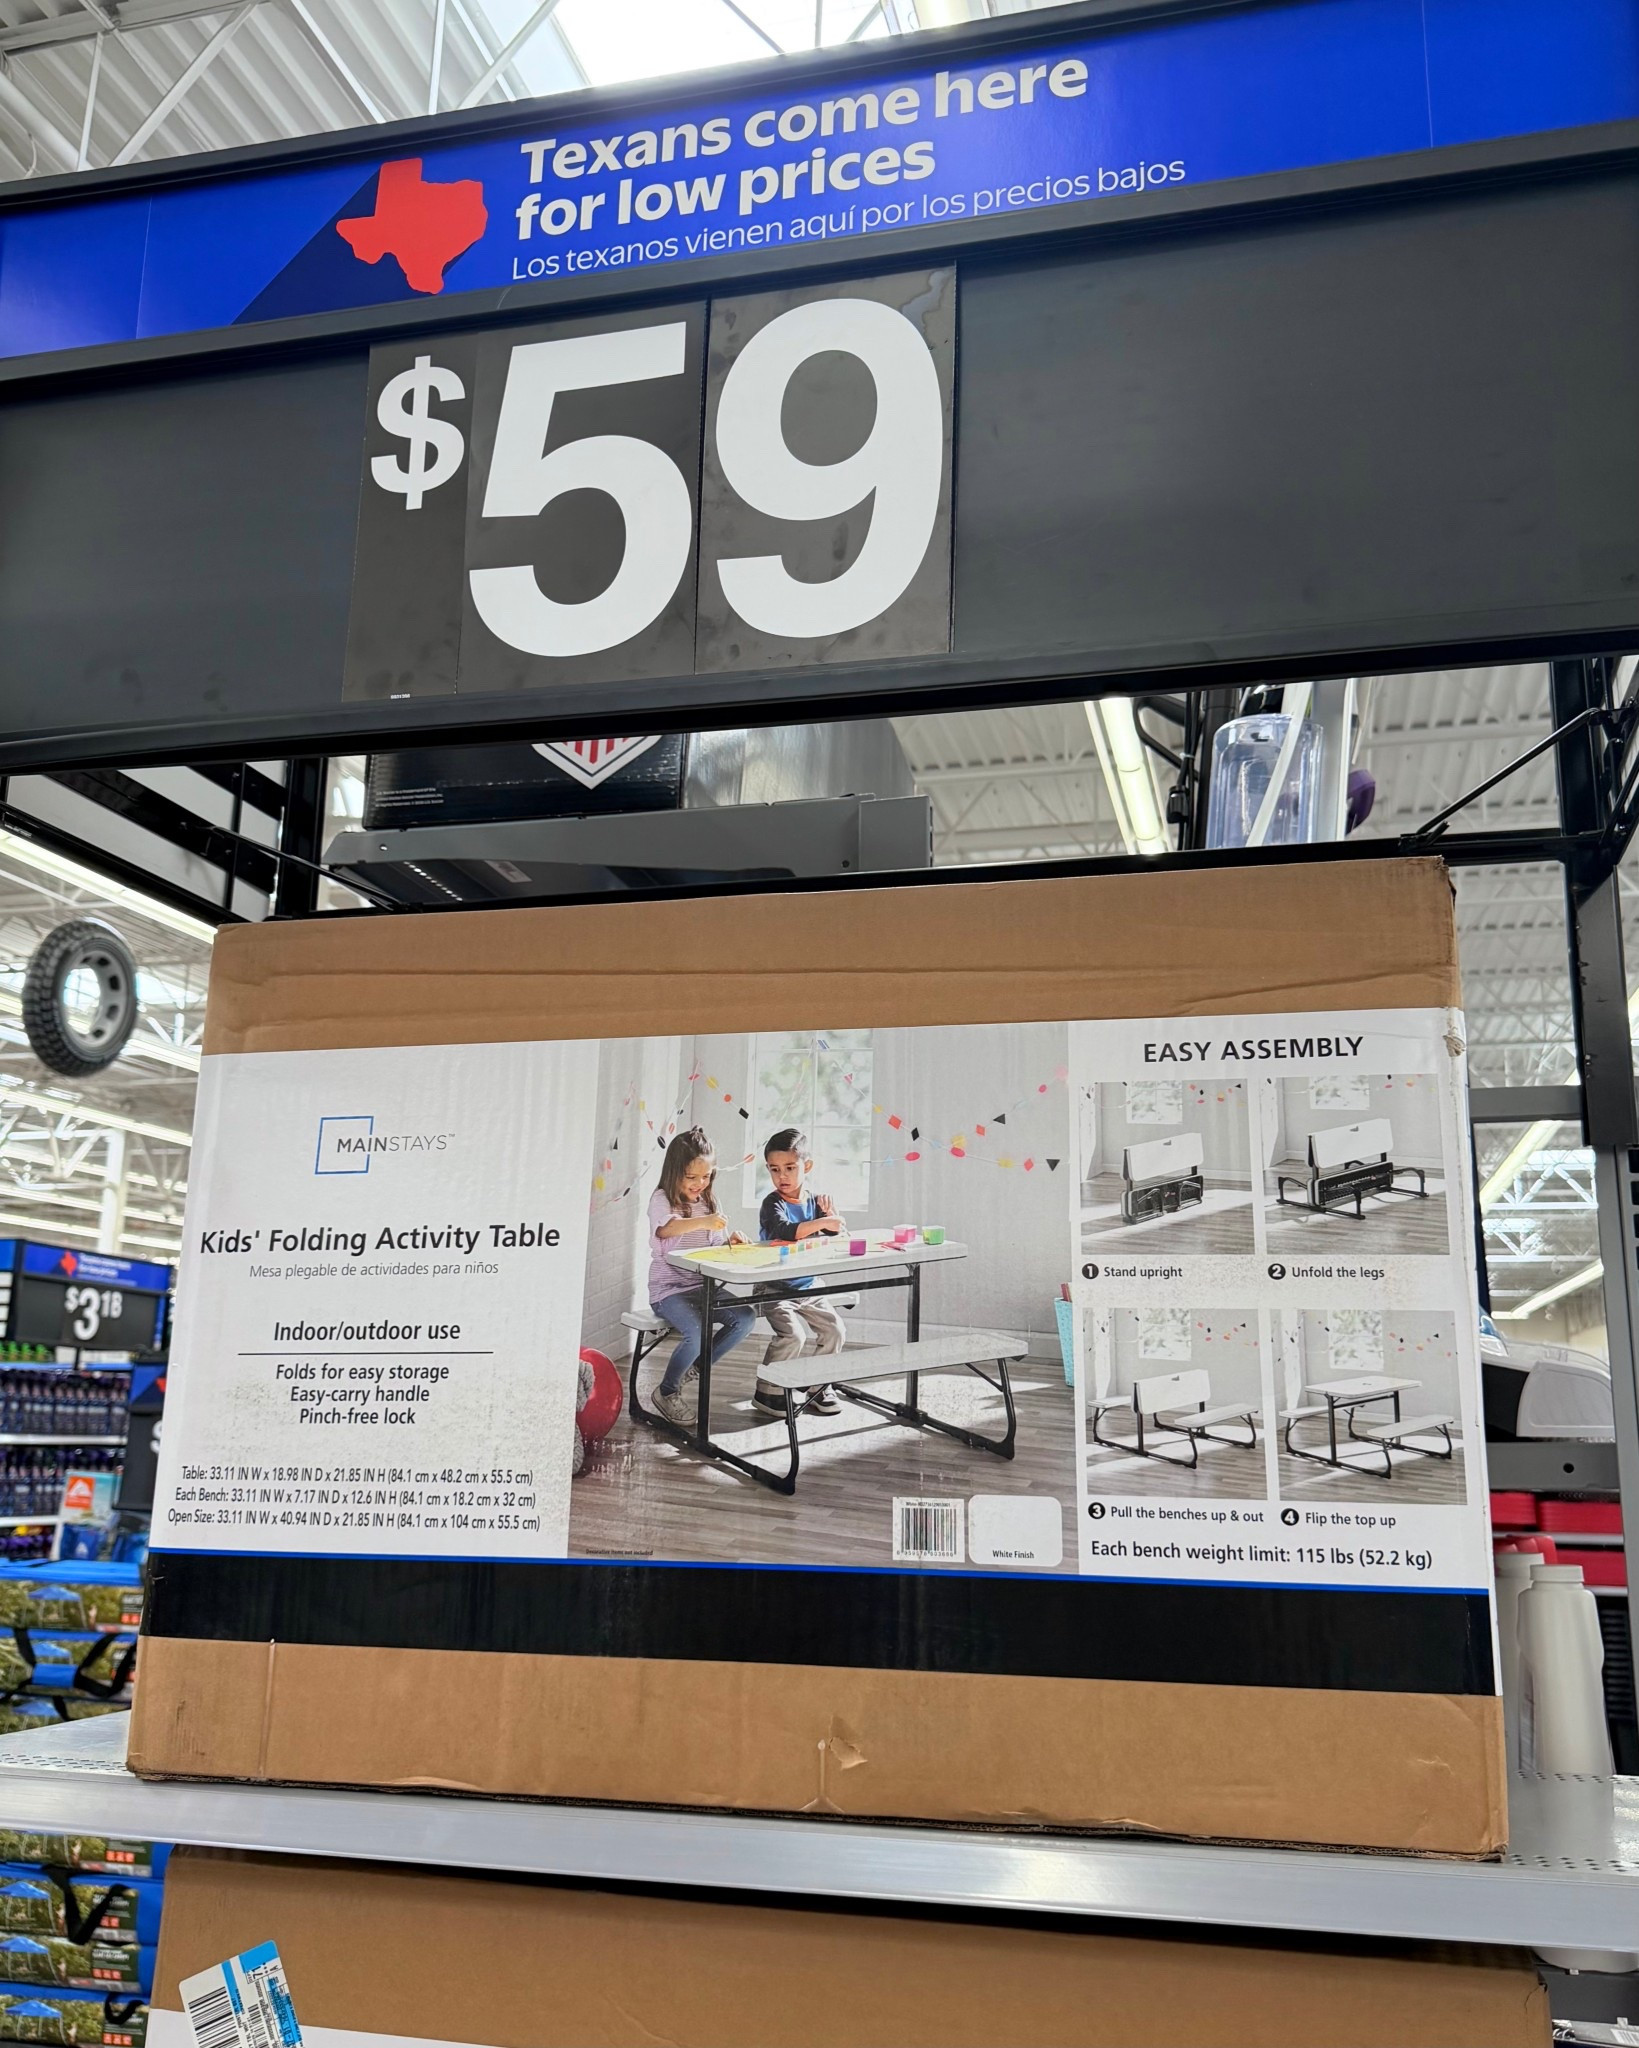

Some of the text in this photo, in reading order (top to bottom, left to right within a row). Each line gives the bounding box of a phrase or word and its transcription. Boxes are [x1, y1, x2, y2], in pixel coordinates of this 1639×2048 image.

[521, 58, 1089, 184] Texans come here
[515, 141, 936, 240] for low prices
[512, 159, 1186, 280] Los texanos vienen aquí por los precios bajos
[371, 298, 943, 657] $59
[1144, 1036, 1364, 1063] EASY ASSEMBLY
[200, 1223, 560, 1256] Kids' Folding Activity Table
[250, 1261, 499, 1280] Mesa plegable de actividades para niños
[1104, 1266, 1137, 1278] Stand
[1139, 1265, 1182, 1280] upright
[1292, 1266, 1333, 1278] Unfold
[1336, 1266, 1357, 1278] the
[1360, 1266, 1385, 1281] legs
[274, 1320, 461, 1341] Indoor/outdoor use
[276, 1363, 450, 1384] Folds for easy storage
[291, 1385, 430, 1406] Easy-carry handle
[300, 1407, 416, 1424] Pinch-free lock
[182, 1466, 533, 1486] Table: 33.11 IN W x 18.98 IN D x 21.85 IN H (84.1 cm x 48.2 cm x 55.5 cm)
[175, 1487, 536, 1509] Each Bench: 33.11 IN W x 7.17 IN D x 12.6 IN H (84.1 cm x 18.2 cm x 32 cm)
[168, 1508, 540, 1532] Open Size: 33.11 IN W x 40.94 IN D x 21.85 IN H (84.1 cm x 104 cm x 55.5 cm)
[1110, 1506, 1132, 1518] Pull
[1136, 1507, 1155, 1519] the
[1158, 1508, 1207, 1521] benches
[1211, 1511, 1226, 1523] up
[1230, 1511, 1240, 1522] &
[1243, 1511, 1264, 1522] out
[1305, 1512, 1327, 1526] Flip
[1331, 1513, 1352, 1525] the
[1354, 1515, 1377, 1528] top
[1380, 1516, 1396, 1529] up
[992, 1550, 1035, 1559] White Finish
[1091, 1540, 1433, 1570] Each bench weight limit: 115 lbs (52.2 kg)
